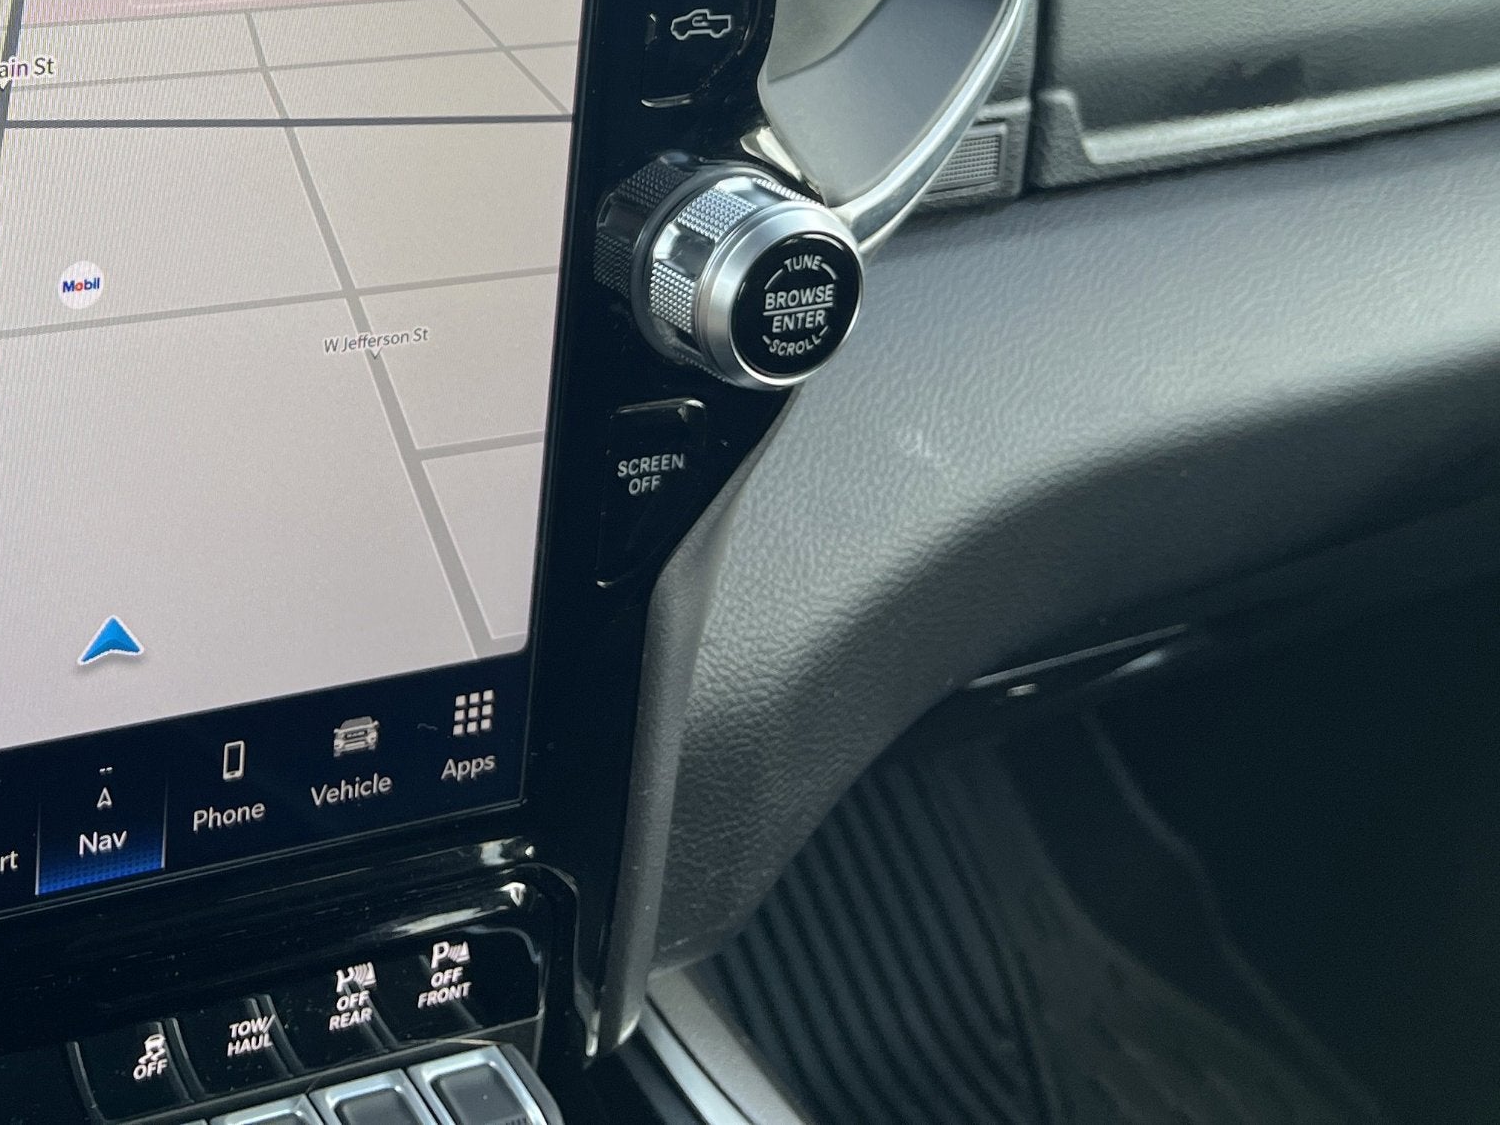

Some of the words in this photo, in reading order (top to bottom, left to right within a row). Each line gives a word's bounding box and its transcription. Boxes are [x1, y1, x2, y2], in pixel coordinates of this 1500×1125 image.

[34, 58, 55, 75] St
[784, 254, 823, 273] TUNE
[765, 284, 835, 310] BROWSE
[772, 309, 825, 333] ENTER
[324, 337, 338, 353] W
[341, 330, 409, 353] Jefferson
[413, 327, 429, 343] St
[769, 334, 821, 356] SCROLL
[617, 453, 684, 477] SCREEN
[628, 475, 661, 495] OFF
[441, 754, 496, 782] Apps
[310, 773, 393, 807] Vehicle
[193, 801, 266, 832] Phone
[79, 830, 127, 857] Nav
[431, 967, 463, 988] OFF
[336, 991, 369, 1012] OFF
[418, 981, 472, 1009] FRONT
[229, 1014, 276, 1038] TOW/
[329, 1007, 373, 1031] REAR
[227, 1034, 272, 1057] HAUL
[133, 1059, 168, 1080] OFF
